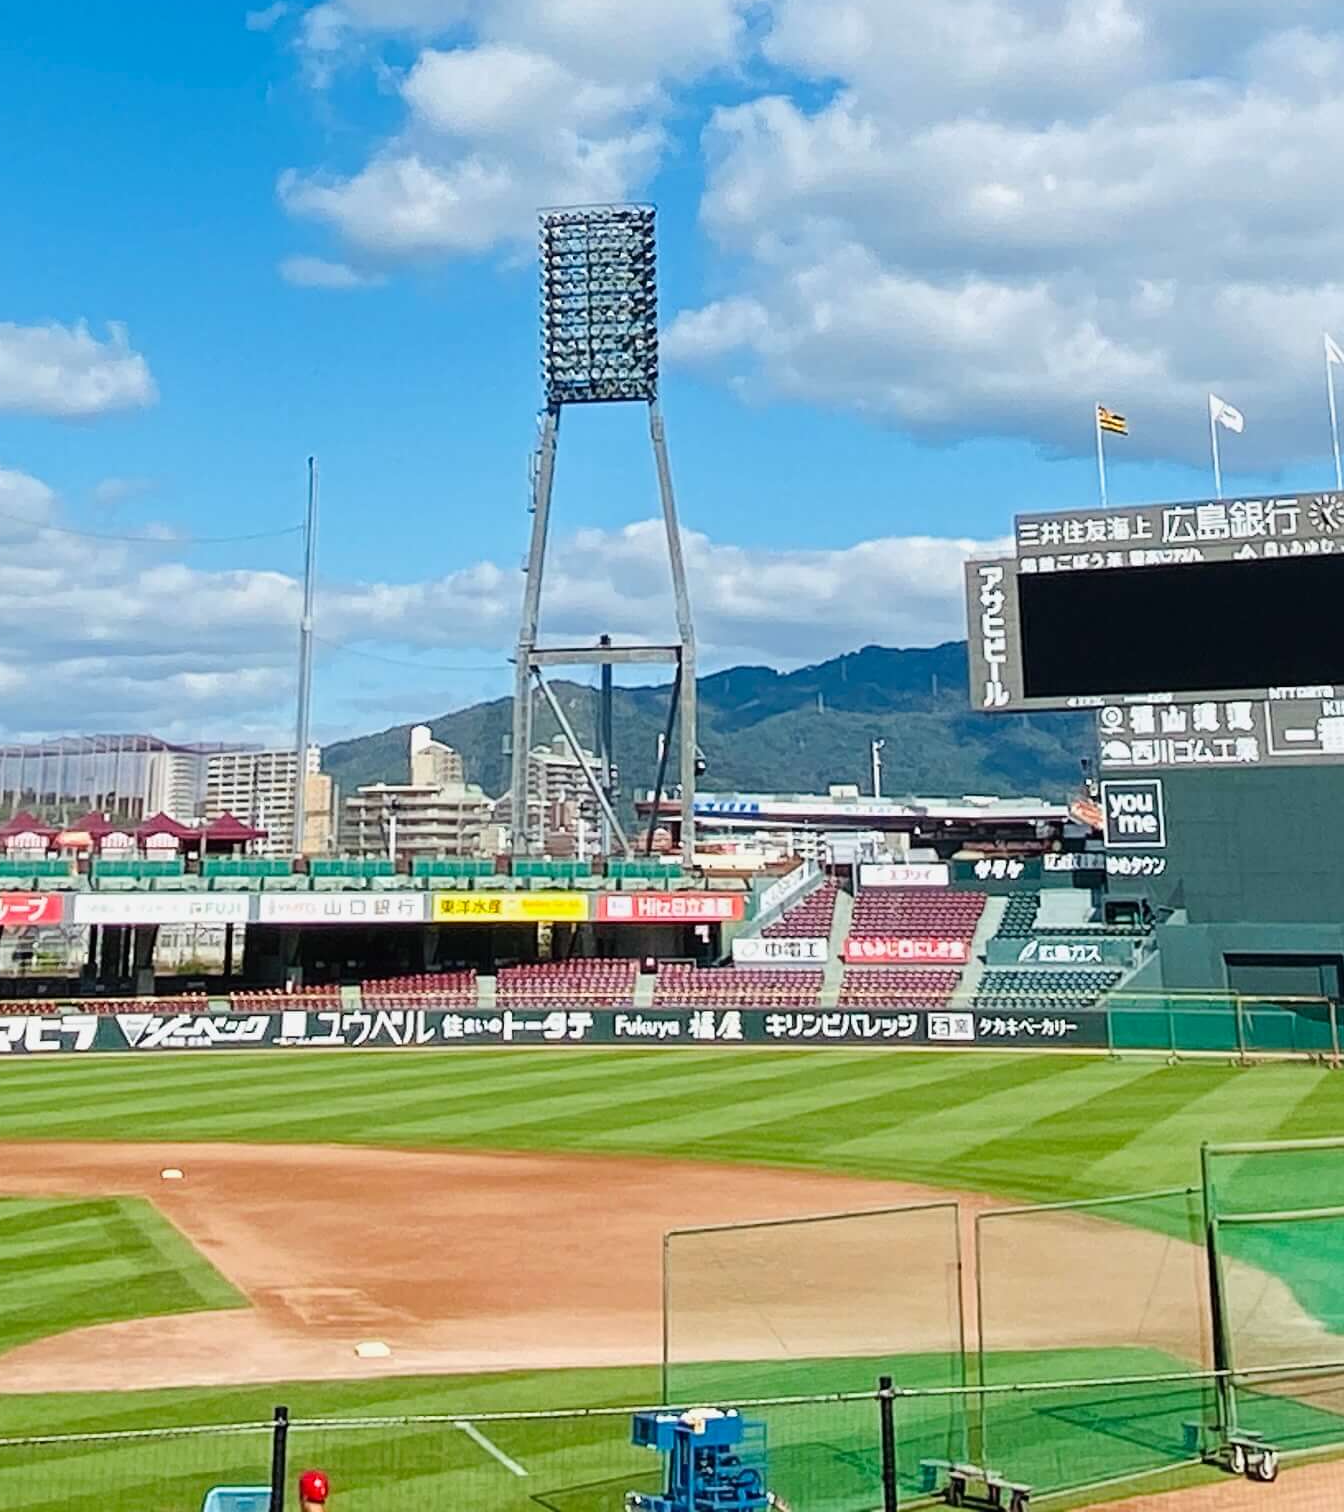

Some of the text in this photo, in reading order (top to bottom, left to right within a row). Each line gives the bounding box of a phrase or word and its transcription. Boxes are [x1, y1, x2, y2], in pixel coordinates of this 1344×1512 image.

[1018, 515, 1153, 547] 三井住友海上
[1162, 499, 1301, 543] 広島銀行
[978, 566, 1010, 708] アサヒビール
[1131, 736, 1259, 765] 西川ゴム工業
[1108, 793, 1153, 819] you
[1117, 812, 1159, 834] me
[974, 858, 1025, 880] サタケ
[1105, 856, 1167, 876] ゆめタウン
[204, 901, 243, 915] FUJI
[323, 899, 416, 915] 山口銀行
[440, 899, 502, 915] 東洋水産
[763, 941, 820, 959] 中電工
[1038, 945, 1103, 963] 広島ガス
[301, 1010, 435, 1046] ユウベル
[614, 1010, 744, 1040] Fukuya 福屋
[765, 1013, 919, 1038] キリンビバレッジ
[978, 1016, 1079, 1037] タカキベーカリー
